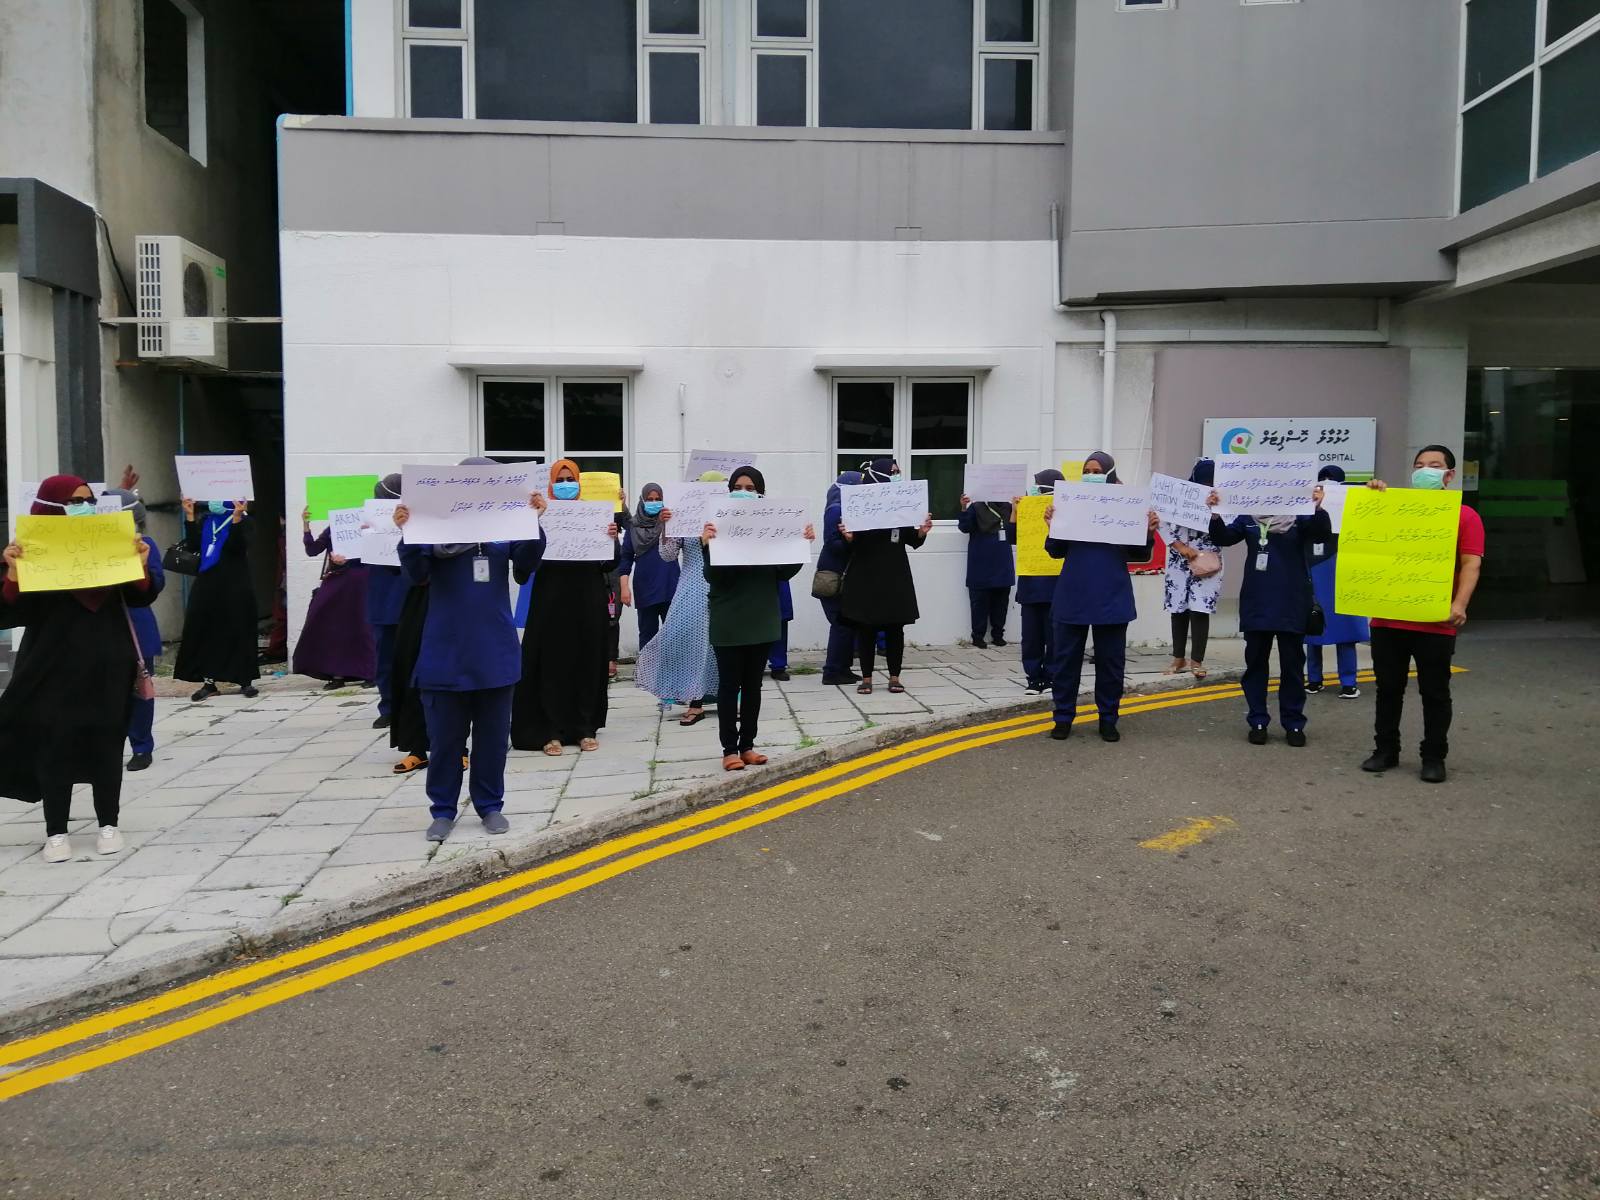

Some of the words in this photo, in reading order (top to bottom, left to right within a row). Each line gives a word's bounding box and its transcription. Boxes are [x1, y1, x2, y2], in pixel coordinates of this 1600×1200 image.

[1260, 429, 1309, 451] ހޮސްޕިޓަލް
[1316, 428, 1350, 445] ހުޅުމާލެ
[1318, 453, 1355, 462] OSPITAL
[1154, 479, 1174, 493] WHY
[1179, 482, 1201, 501] THIS
